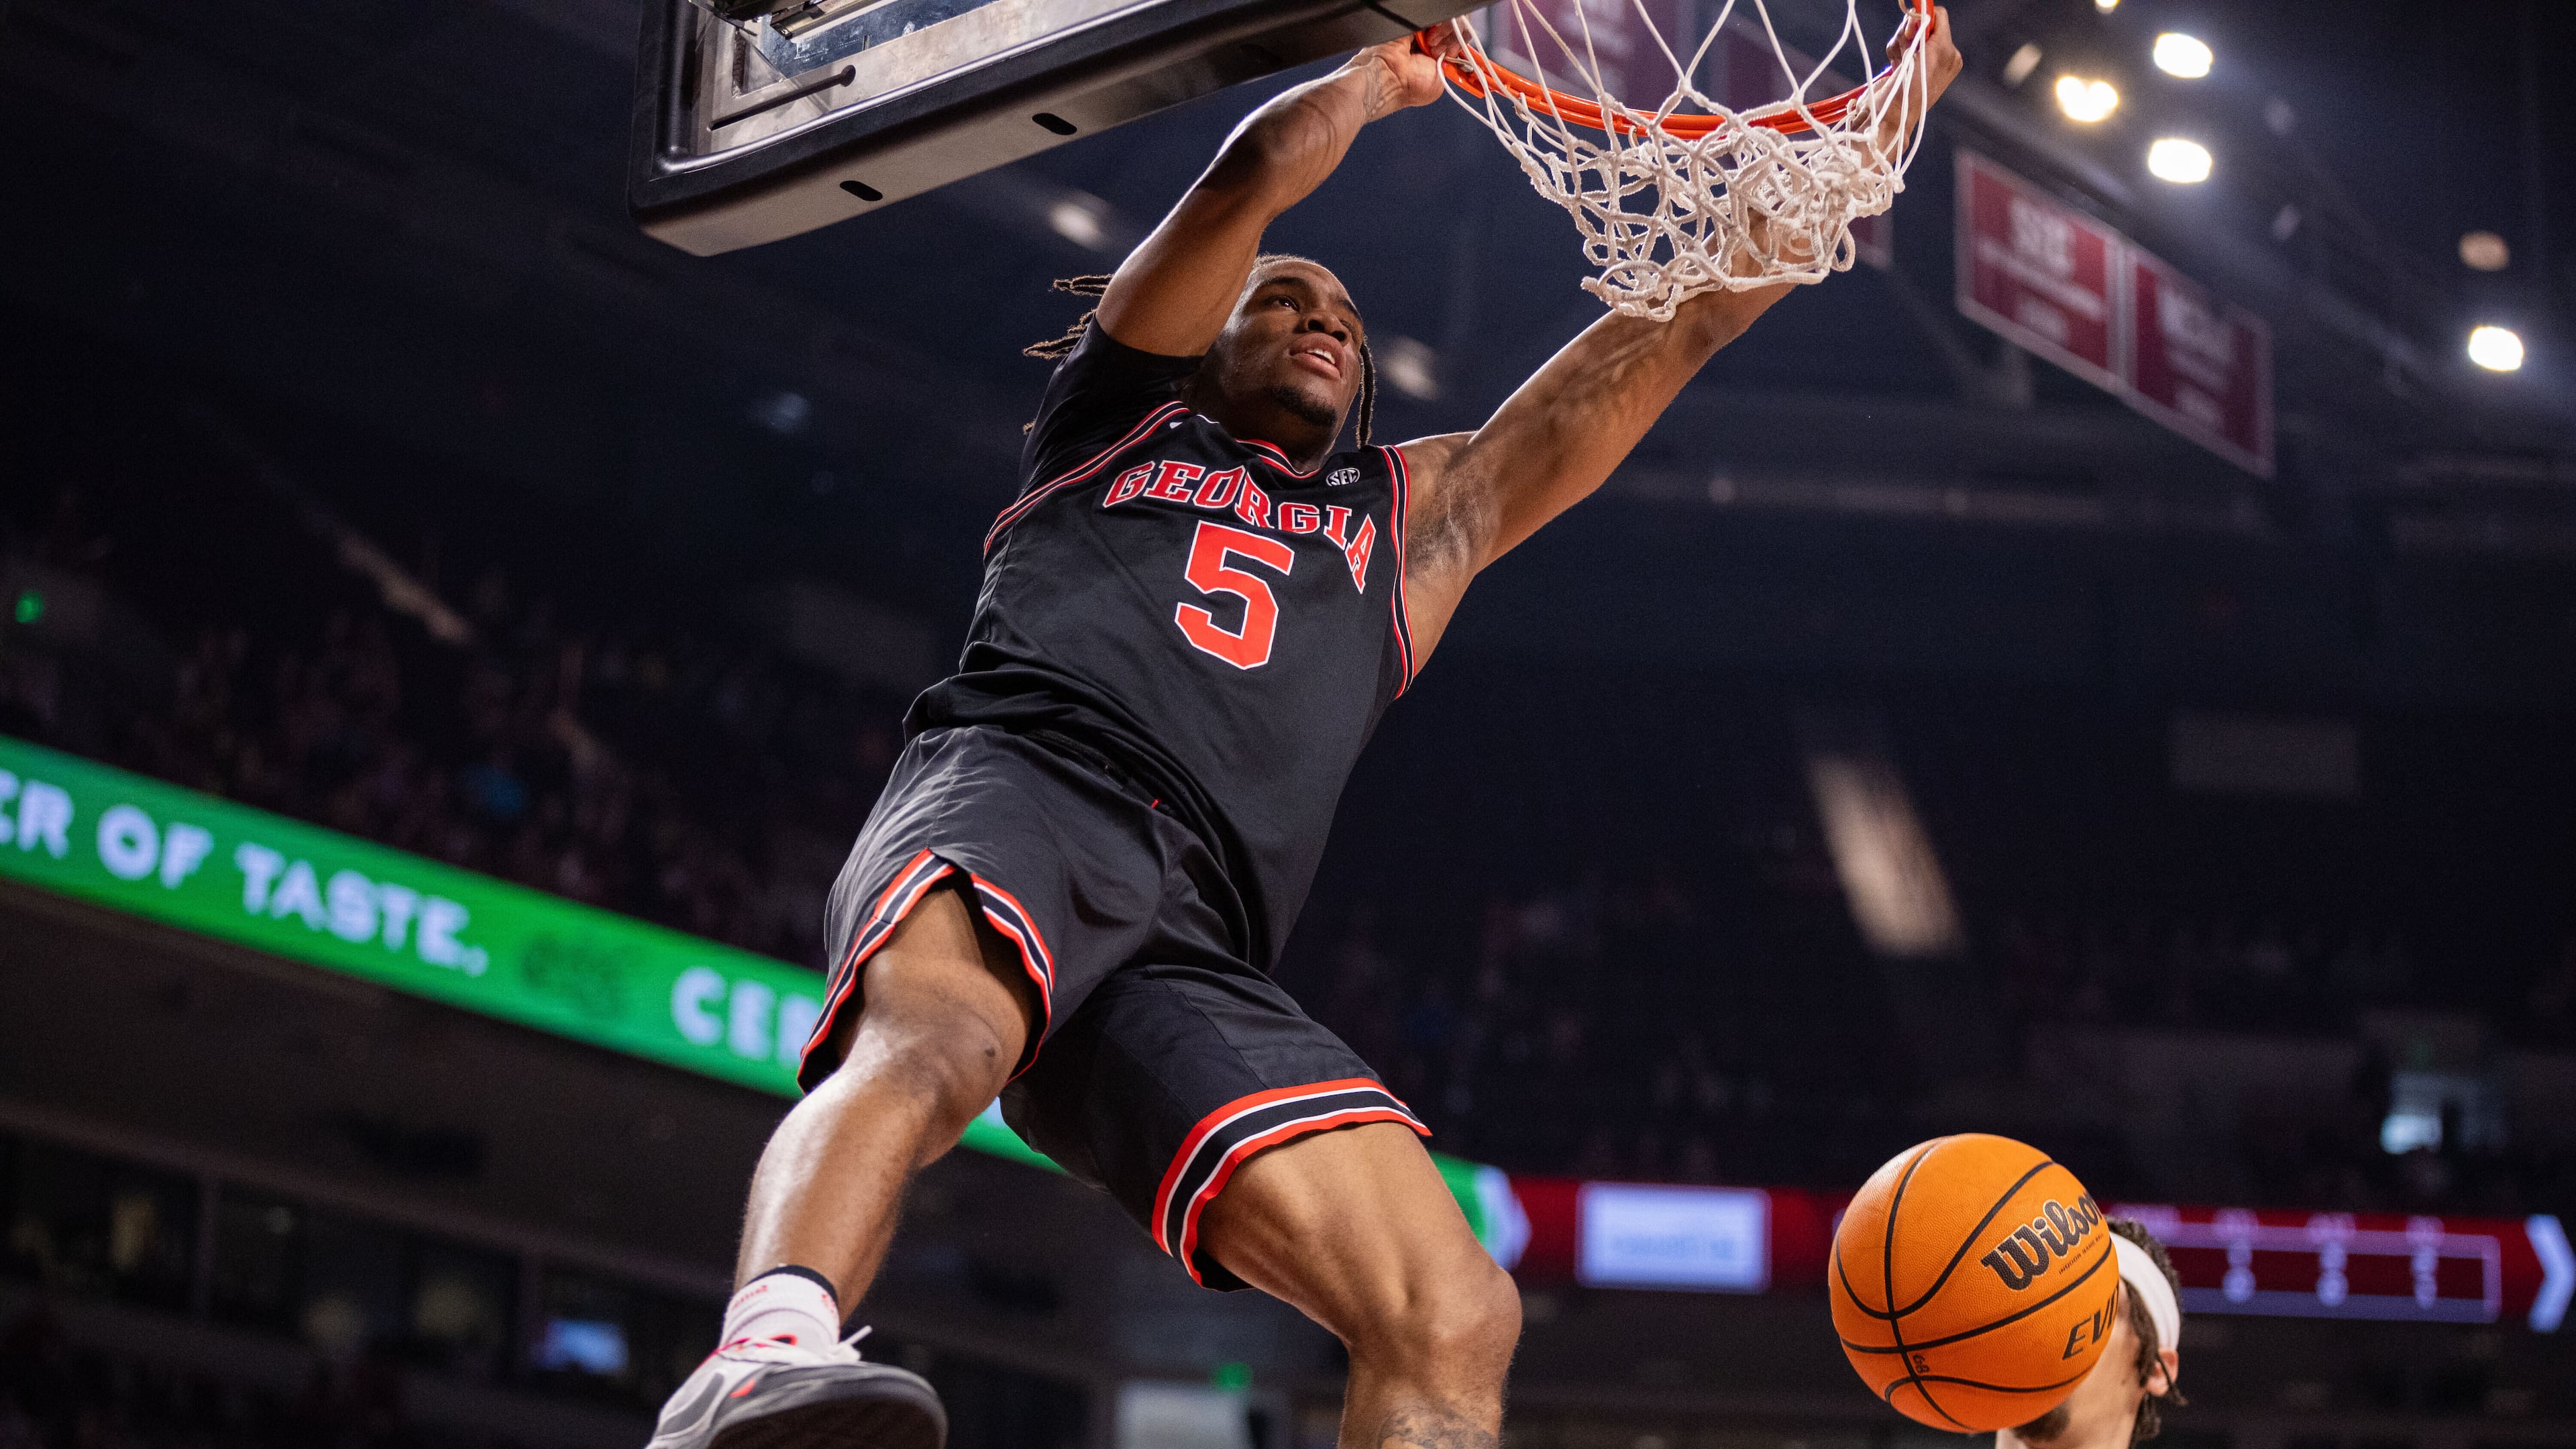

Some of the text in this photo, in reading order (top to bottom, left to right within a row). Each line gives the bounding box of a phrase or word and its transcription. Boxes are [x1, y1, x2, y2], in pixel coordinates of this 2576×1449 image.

[1102, 460, 1376, 594] GEORGIA
[1330, 470, 1356, 486] SEC
[1175, 519, 1295, 670] 5
[96, 804, 214, 891] OF
